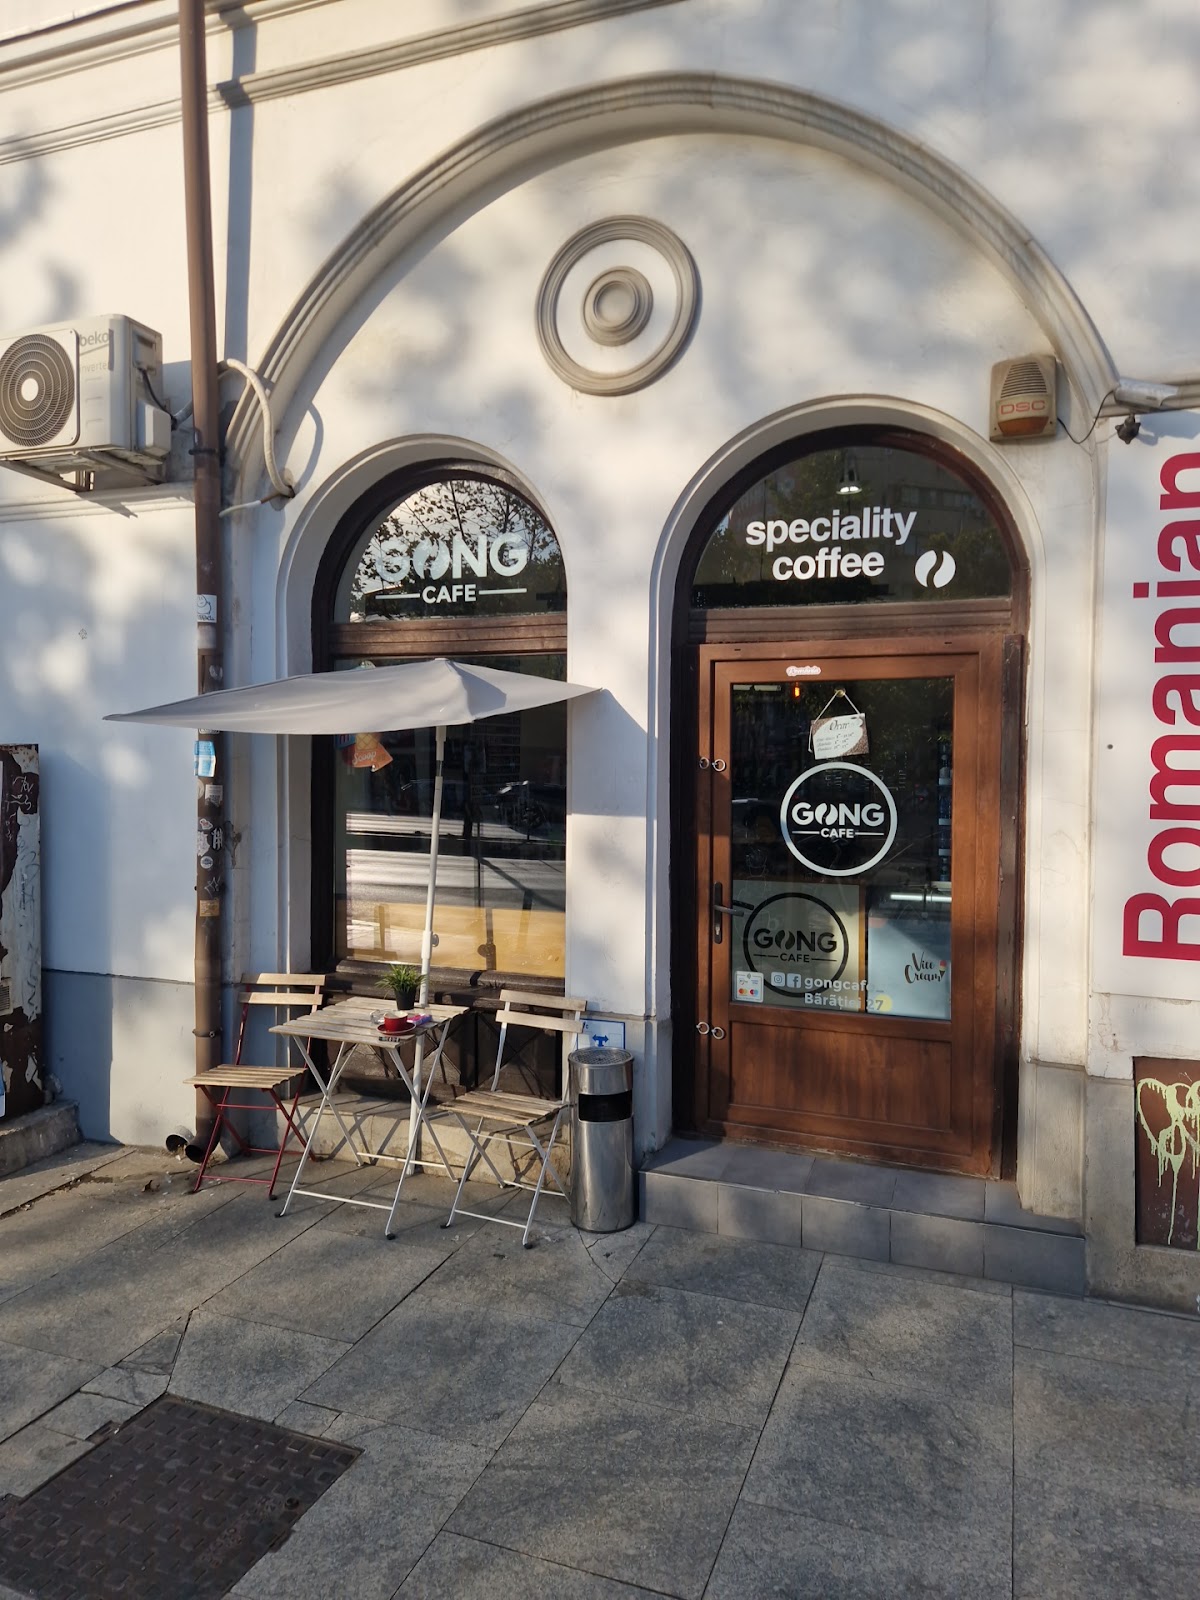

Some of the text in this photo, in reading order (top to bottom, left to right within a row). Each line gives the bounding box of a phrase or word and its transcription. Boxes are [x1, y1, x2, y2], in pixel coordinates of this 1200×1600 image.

[80, 331, 109, 347] beko
[1000, 400, 1045, 415] DSC
[745, 506, 917, 552] speciality
[375, 532, 528, 582] GONG
[772, 546, 885, 581] coffee
[422, 583, 477, 604] CAFE
[791, 802, 885, 827] GONG
[820, 827, 855, 839] CAFE
[753, 928, 838, 954] GONG
[779, 952, 810, 963] CAFE
[904, 964, 941, 984] Cream
